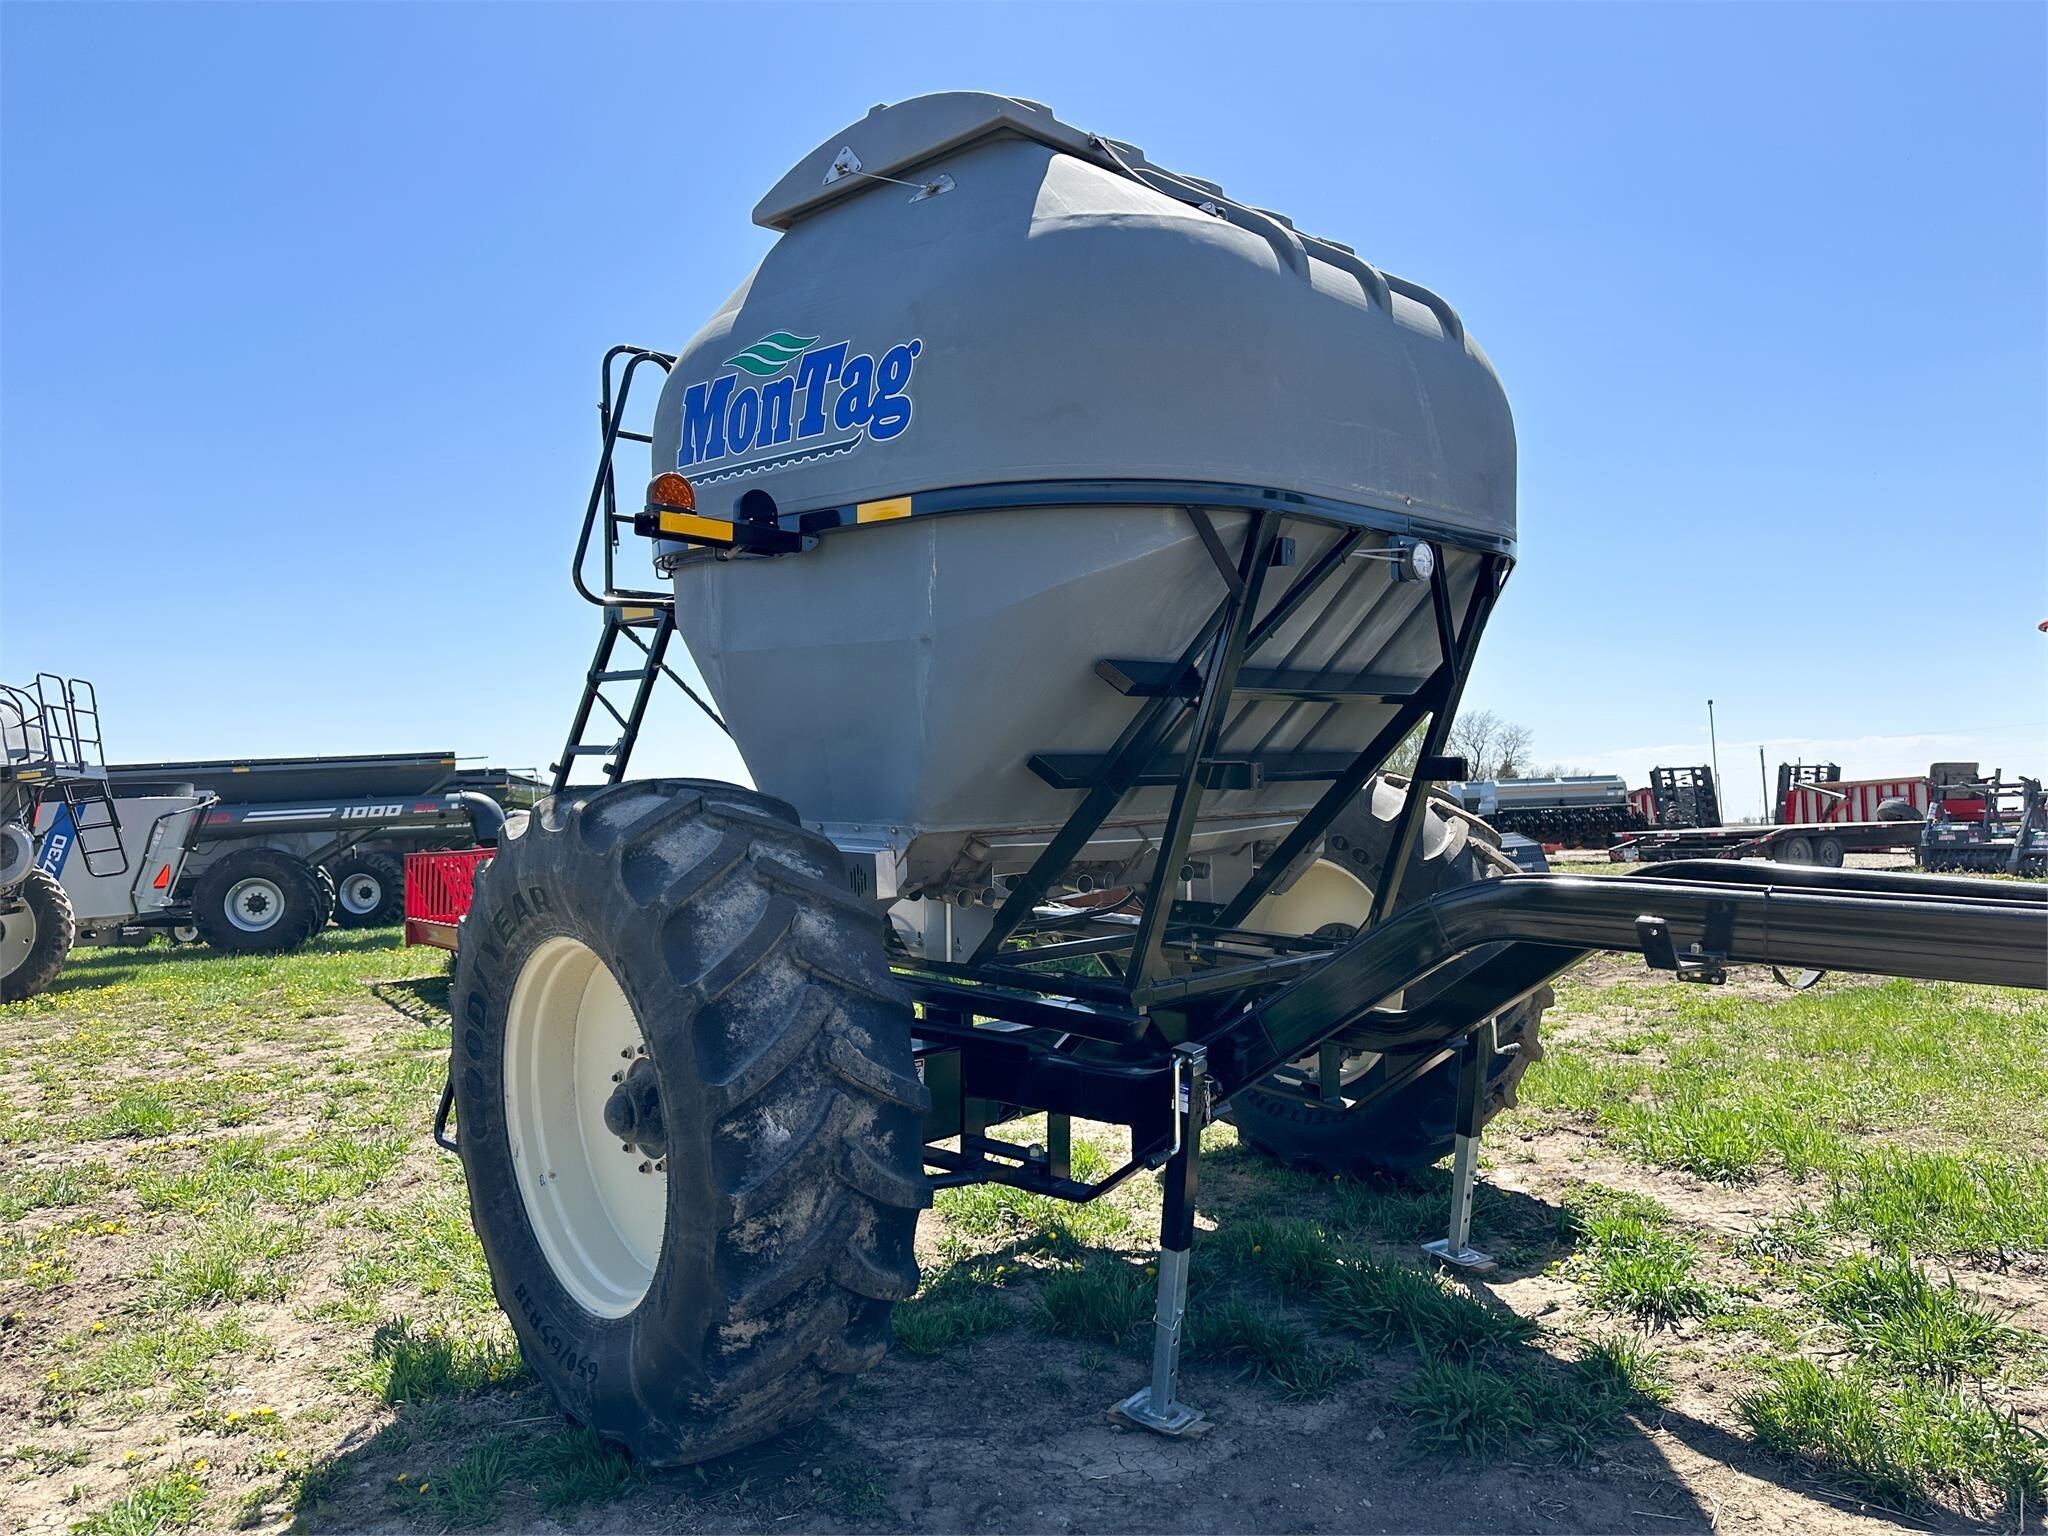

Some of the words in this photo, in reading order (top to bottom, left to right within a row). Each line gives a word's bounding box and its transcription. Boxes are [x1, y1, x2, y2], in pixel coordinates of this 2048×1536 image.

[677, 338, 924, 468] MonTag
[341, 805, 403, 819] 1000
[514, 1282, 598, 1383] 650/65R38
